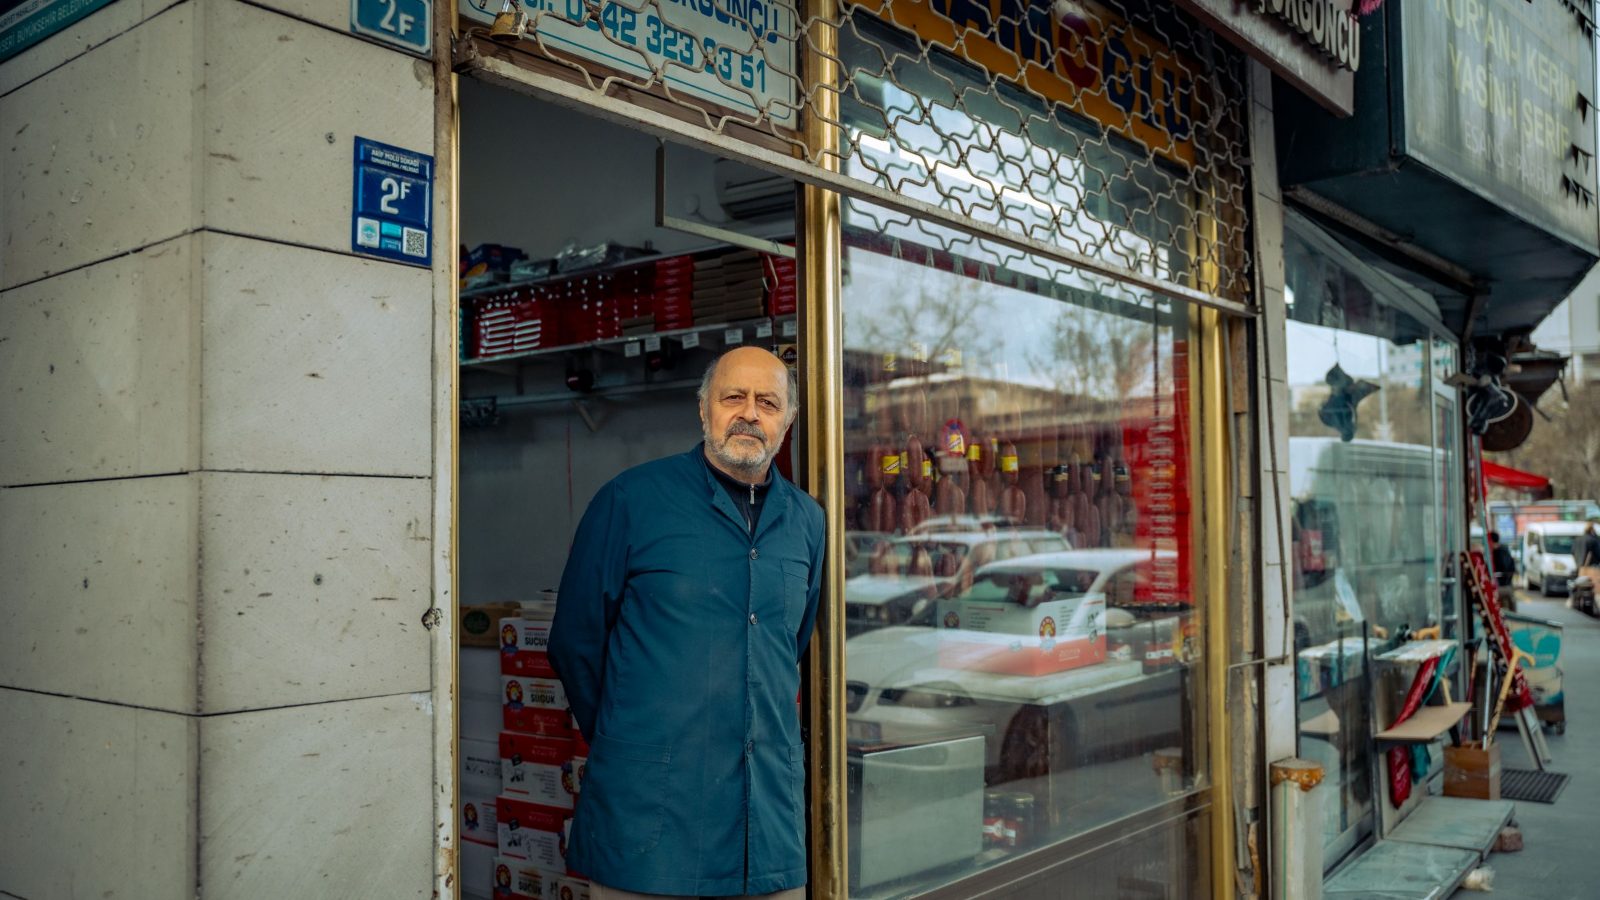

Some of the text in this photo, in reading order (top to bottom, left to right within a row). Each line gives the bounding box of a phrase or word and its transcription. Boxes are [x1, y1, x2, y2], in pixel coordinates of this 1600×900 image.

[379, 0, 414, 36] 2F
[646, 15, 694, 66] 323
[741, 54, 766, 93] 51
[381, 178, 411, 215] 2F
